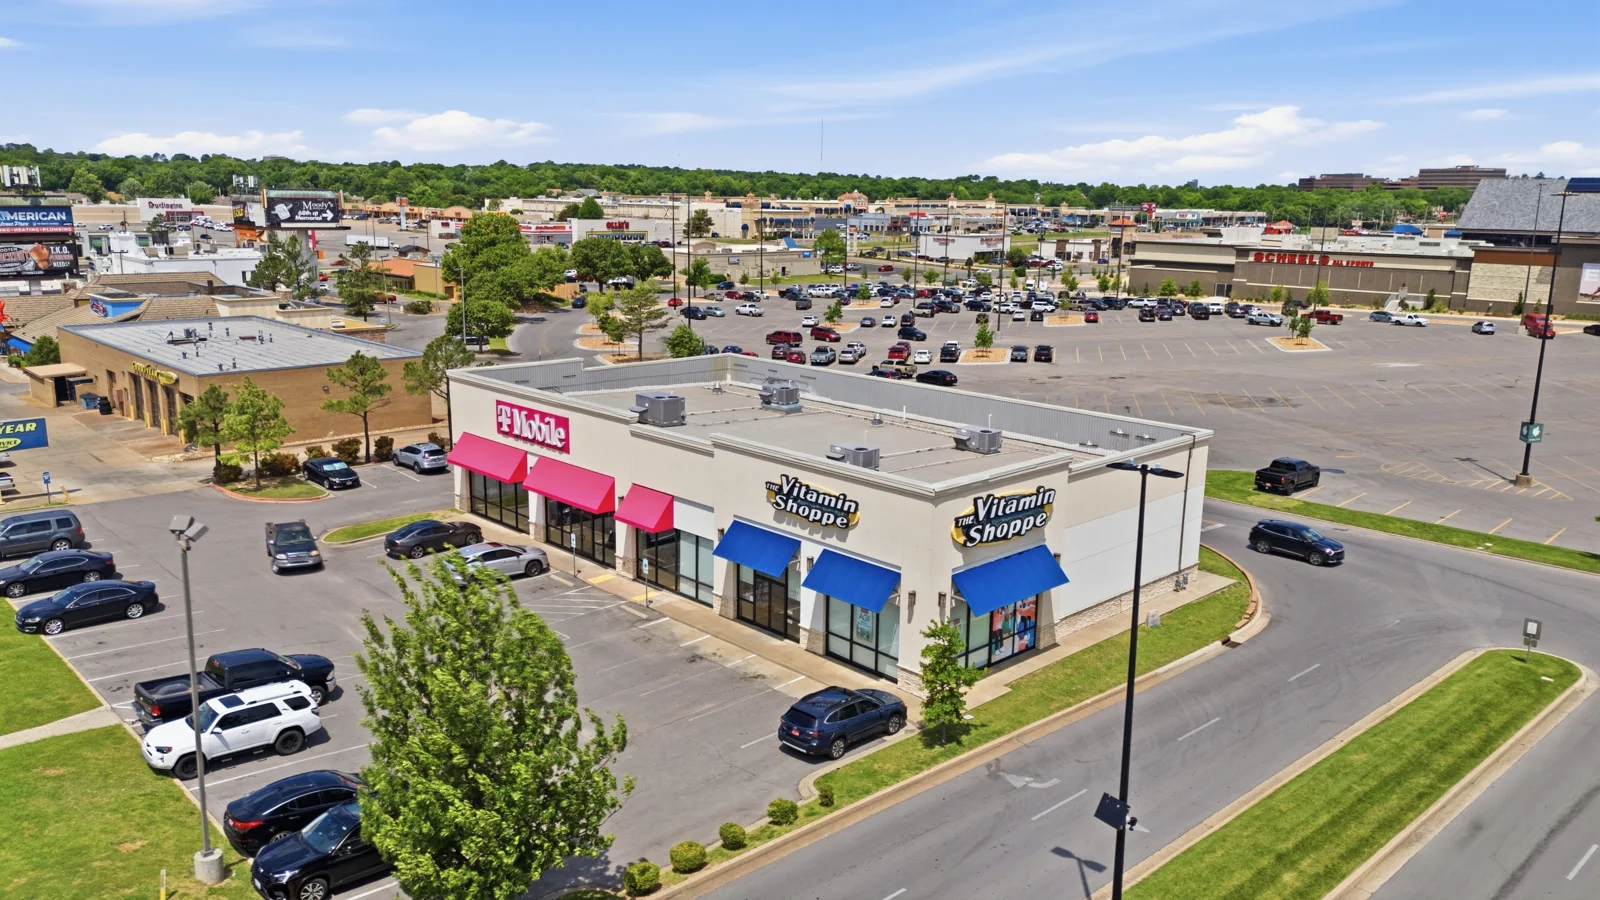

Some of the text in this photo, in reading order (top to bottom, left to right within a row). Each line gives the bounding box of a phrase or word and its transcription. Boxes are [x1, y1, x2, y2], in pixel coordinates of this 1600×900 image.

[302, 201, 334, 210] Moody's
[1254, 252, 1330, 266] SCHEELS
[0, 422, 37, 435] YEAR
[766, 483, 780, 491] THE
[781, 475, 857, 513] Vitamin
[773, 494, 848, 528] Shoppe
[958, 487, 1056, 527] THE Vitamin
[966, 511, 1047, 547] Shoppe
